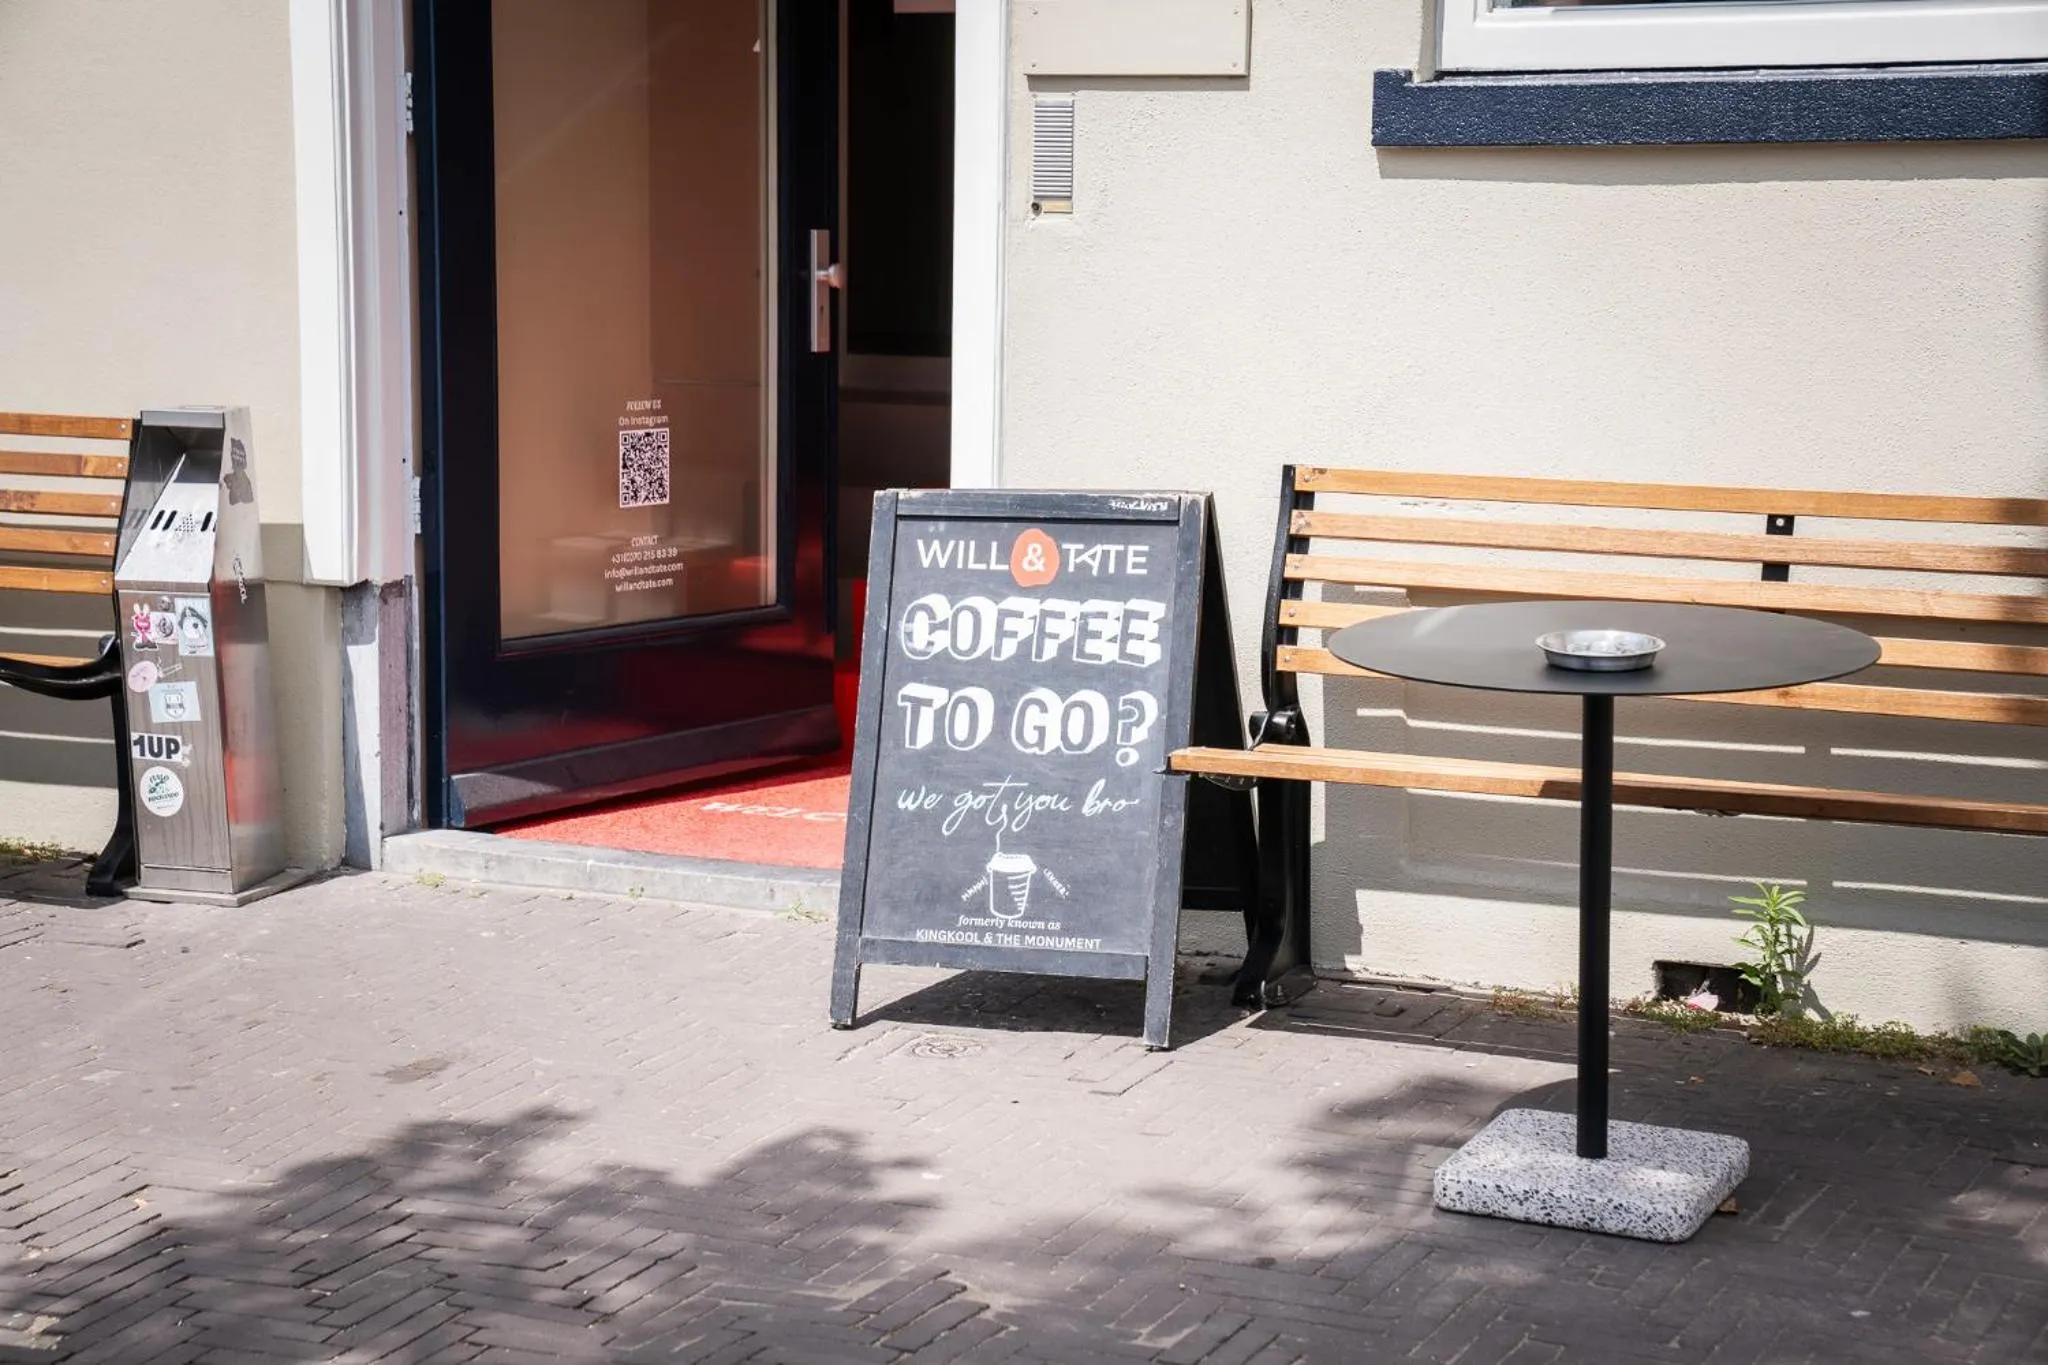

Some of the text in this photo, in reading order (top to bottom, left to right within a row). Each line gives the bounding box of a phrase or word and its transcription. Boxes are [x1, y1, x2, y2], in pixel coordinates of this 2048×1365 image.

[618, 415, 669, 427] On Instagram
[631, 535, 659, 547] CONTACT
[917, 538, 1150, 576] WILL & TATE
[604, 562, 684, 580] info@willandtate.com
[615, 578, 674, 592] willandtate.com
[902, 593, 1167, 667] COFFEE
[897, 682, 1159, 768] TO GO?
[133, 735, 181, 759] 1UP
[897, 775, 1140, 836] we got you bro
[957, 914, 1062, 931] formerly known as
[916, 928, 1102, 952] KINGKOOL & THE MONUMENT
